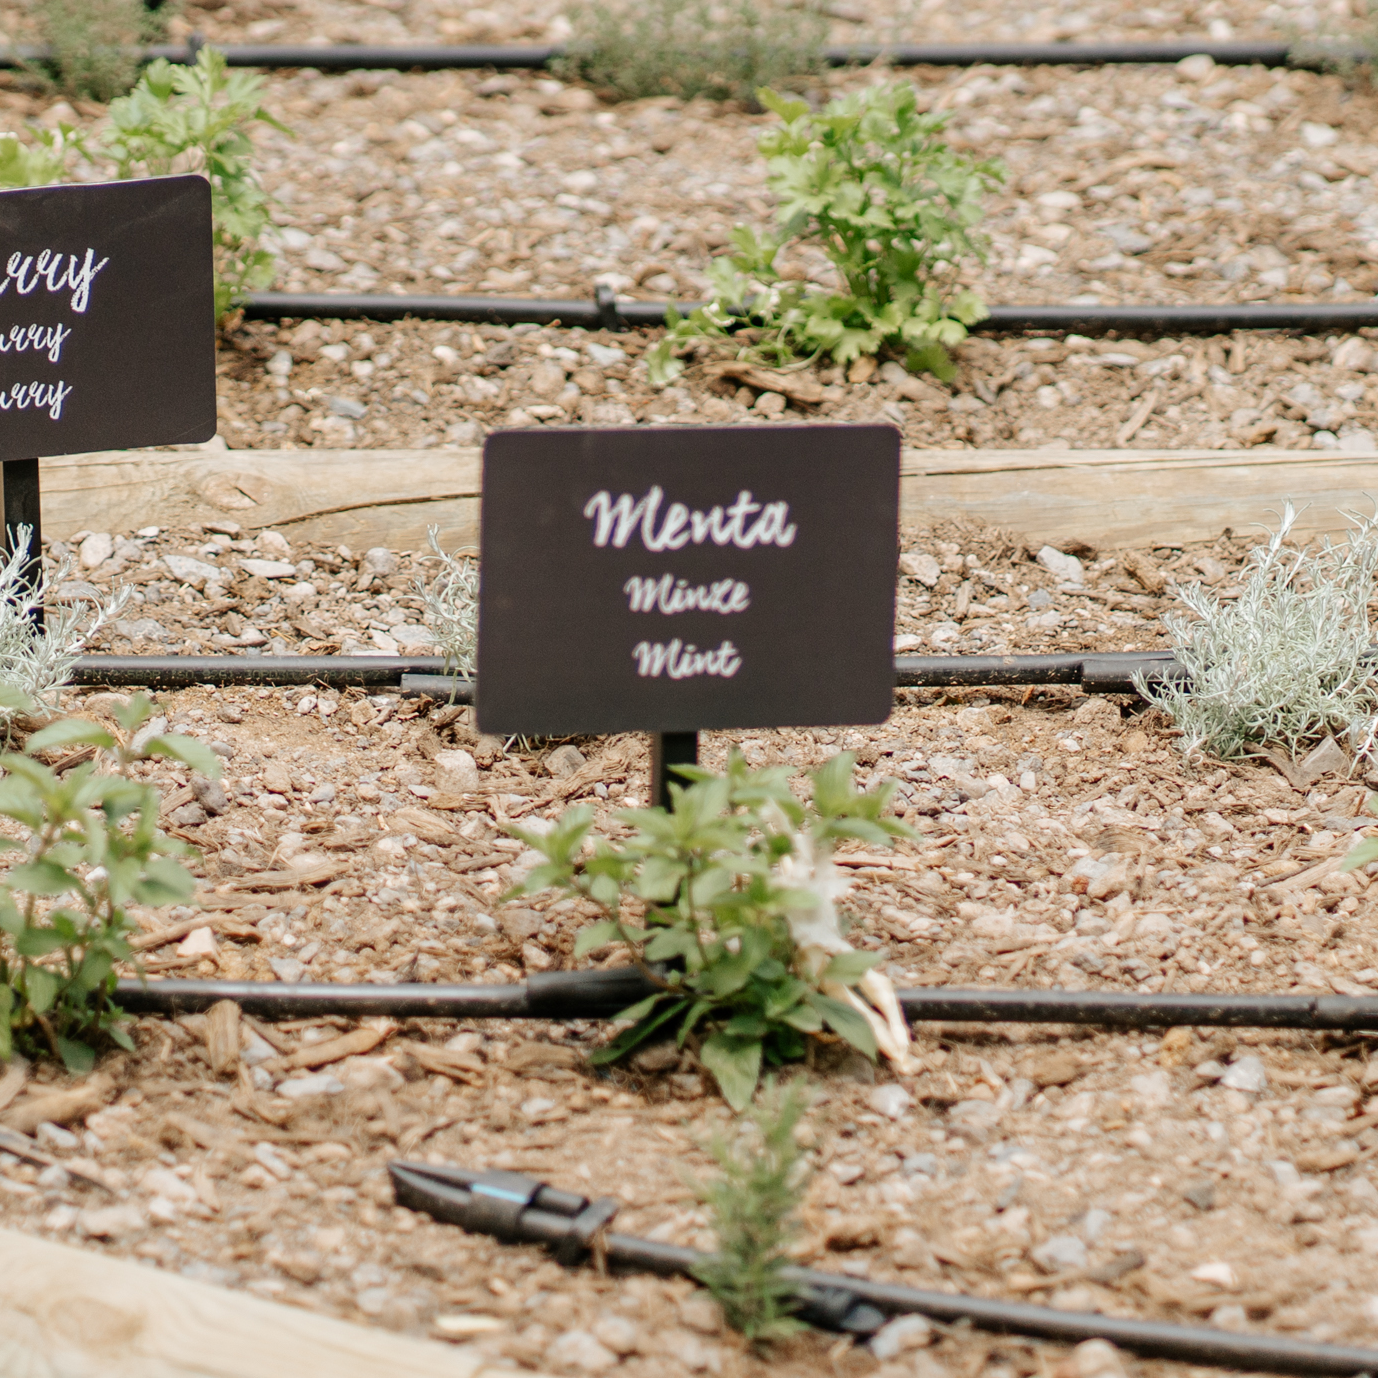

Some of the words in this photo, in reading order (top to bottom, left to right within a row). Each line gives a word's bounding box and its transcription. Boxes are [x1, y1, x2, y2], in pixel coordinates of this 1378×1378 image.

[583, 485, 798, 553] Menta
[624, 573, 752, 615] Minze
[632, 638, 743, 680] Mint
